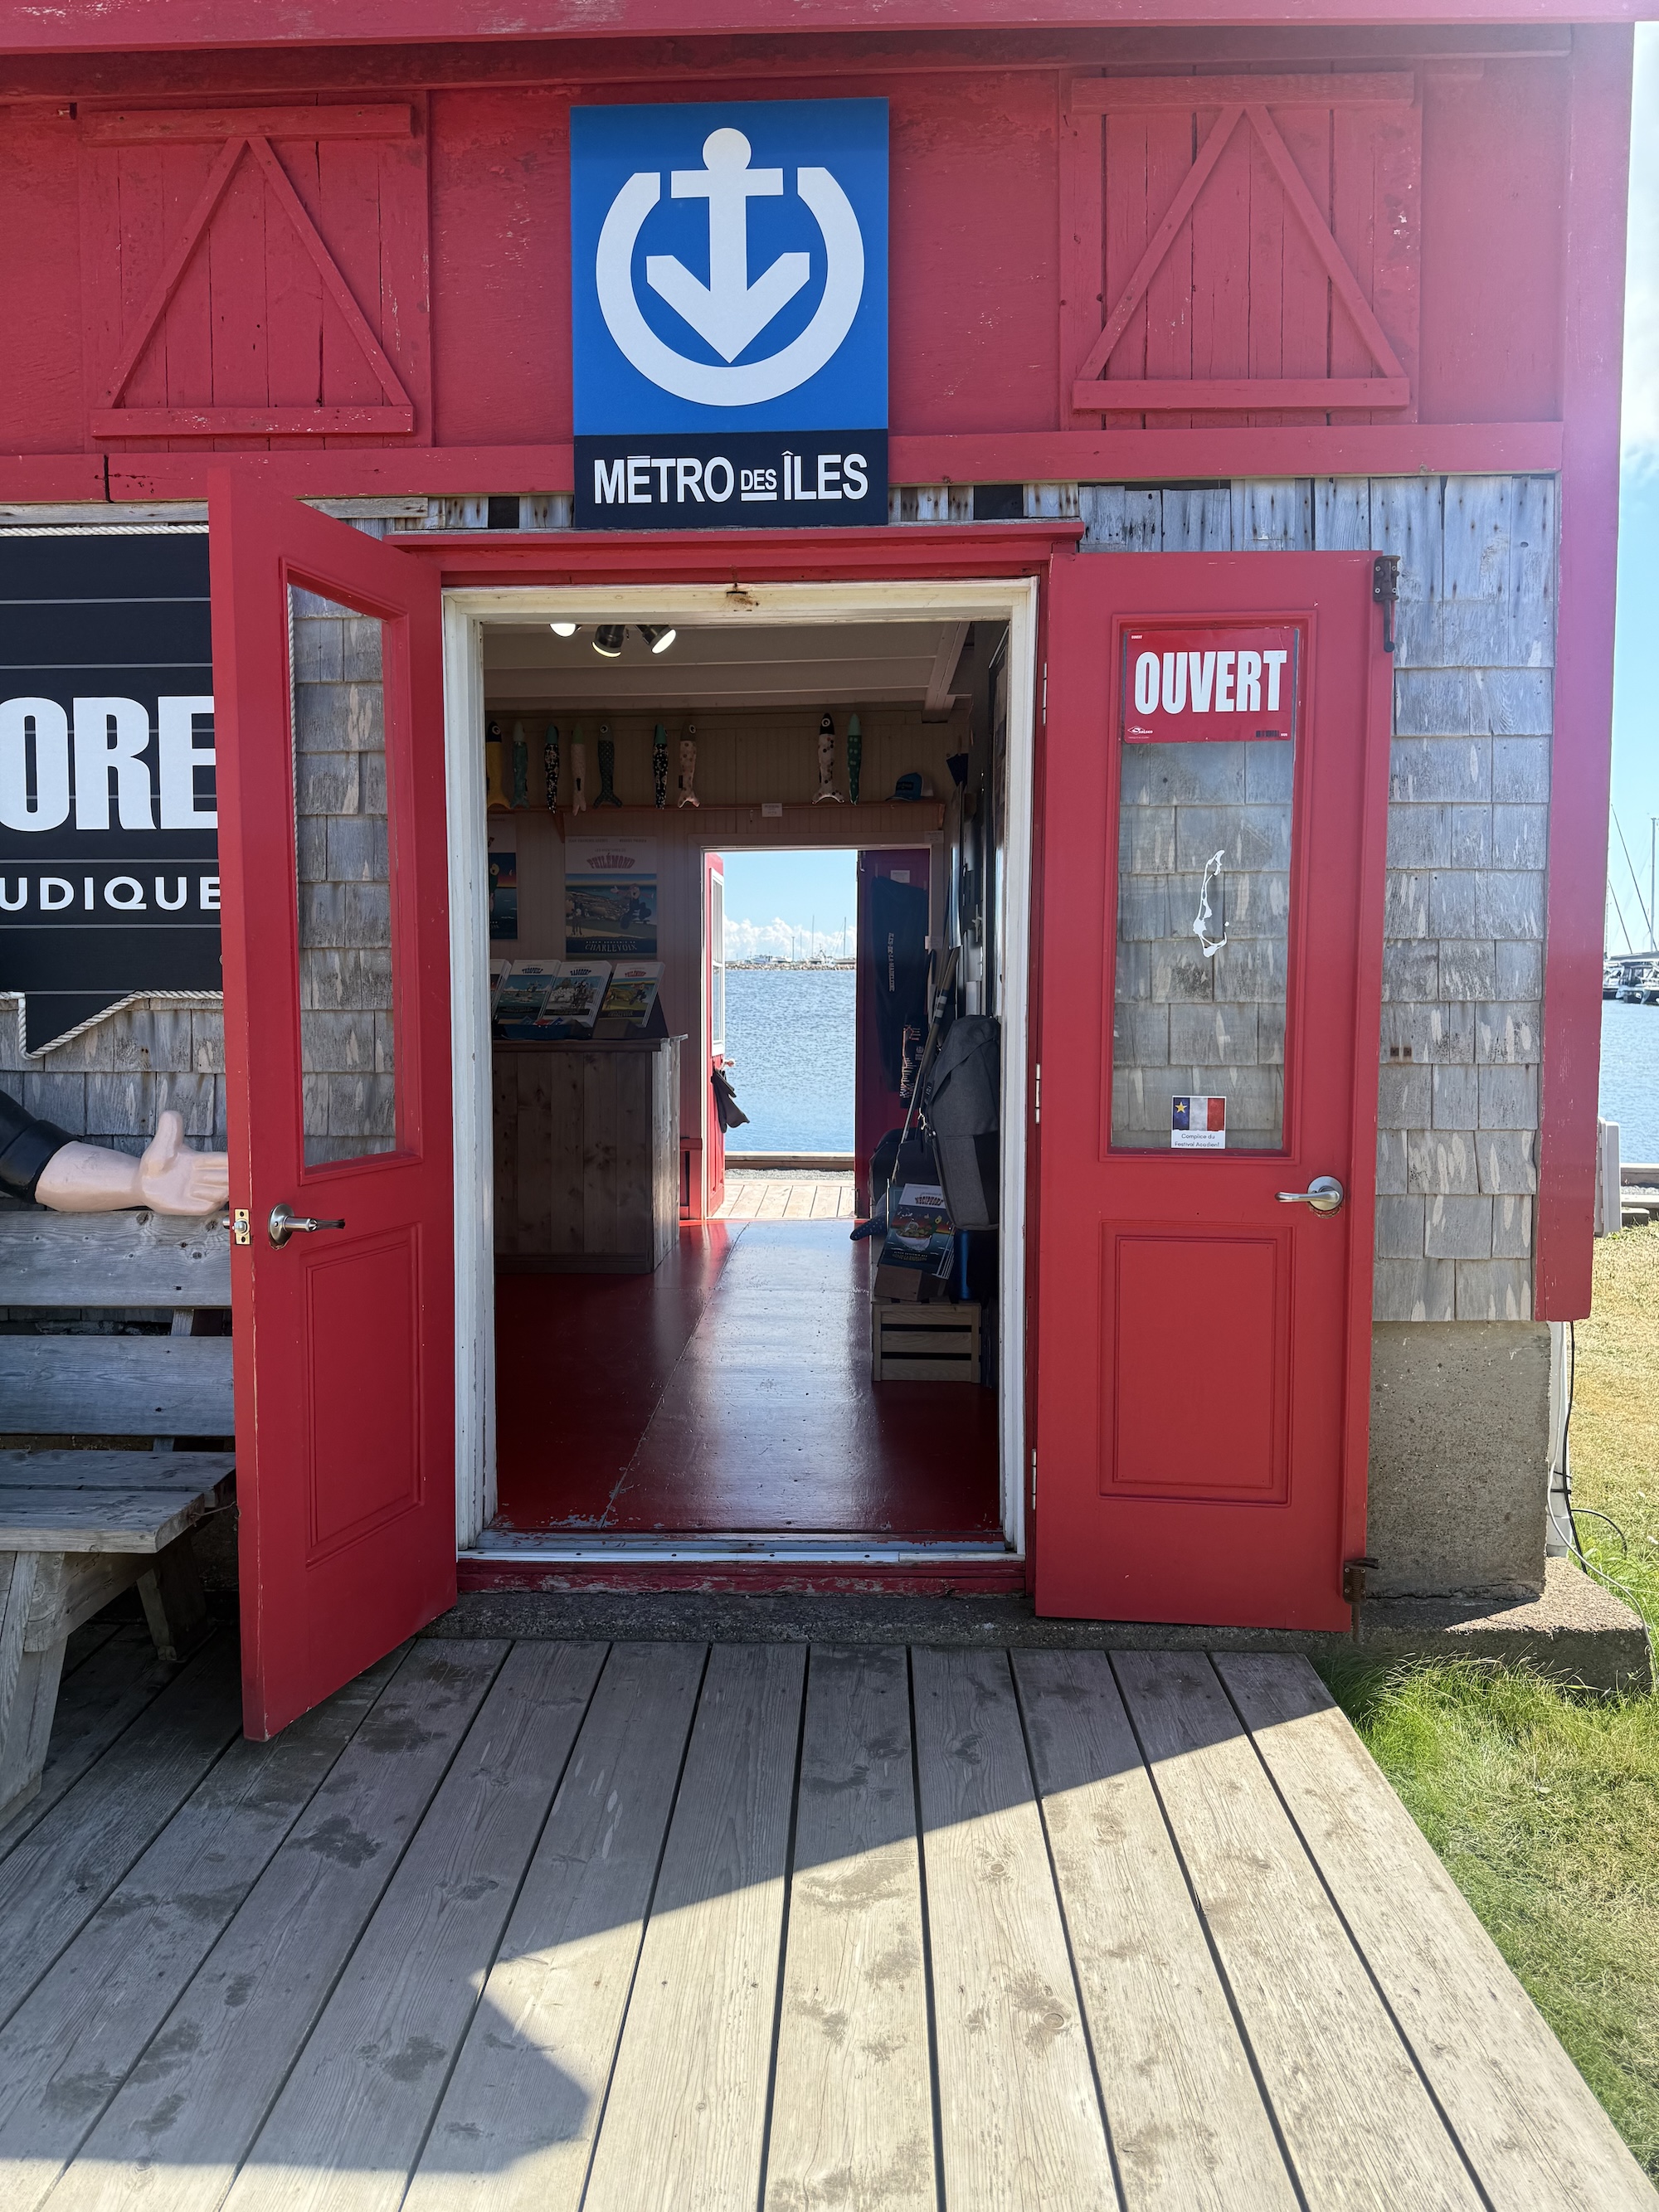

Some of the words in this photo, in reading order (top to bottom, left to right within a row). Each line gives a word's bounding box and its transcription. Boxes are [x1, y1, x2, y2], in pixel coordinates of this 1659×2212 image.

[740, 469, 777, 490] DES
[781, 450, 868, 501] ÎLES
[1134, 650, 1287, 715] OUVERT
[586, 853, 635, 869] PHILÉMOND
[585, 944, 637, 952] CHARLEVOIX
